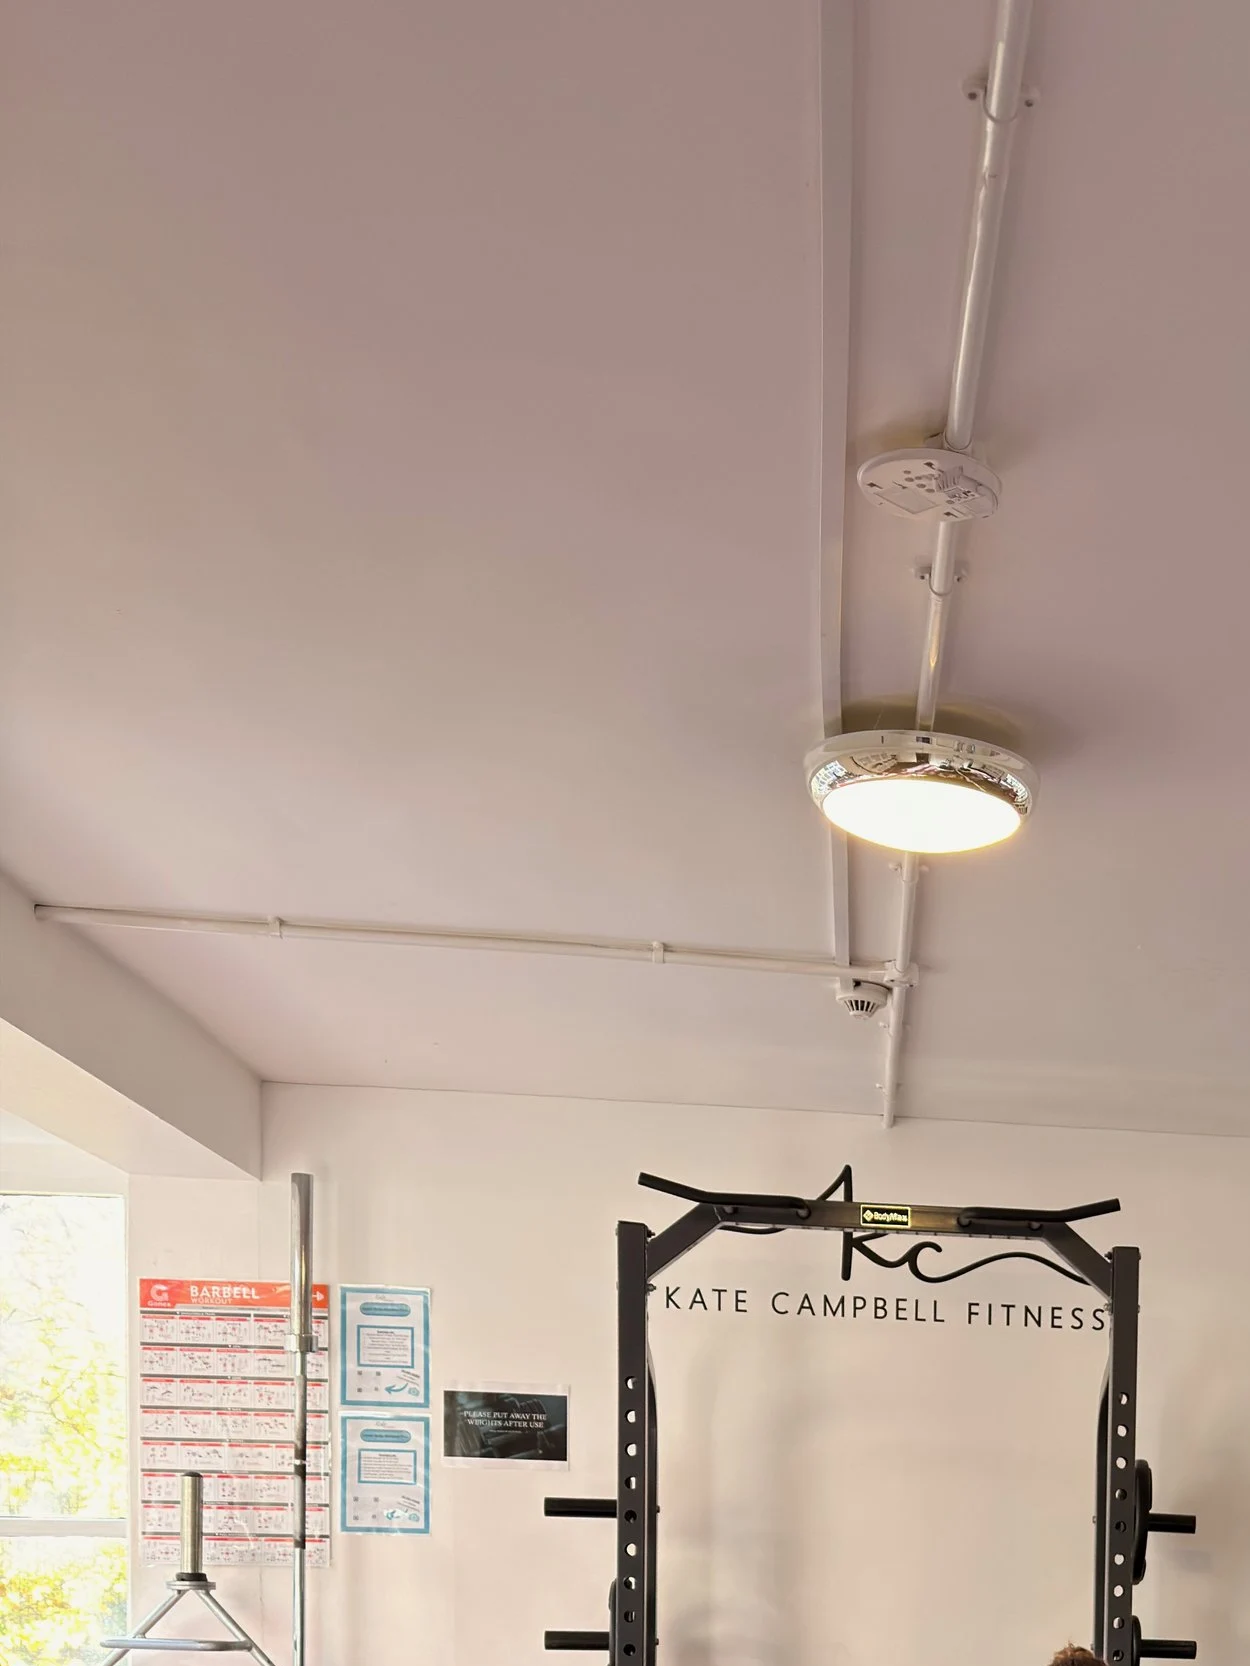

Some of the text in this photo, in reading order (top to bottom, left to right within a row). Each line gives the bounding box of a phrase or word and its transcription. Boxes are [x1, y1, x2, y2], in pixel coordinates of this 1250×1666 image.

[873, 1211, 908, 1223] BodyMax
[190, 1285, 260, 1299] BARBELL
[664, 1285, 1105, 1331] KATE CAMPBELL FITNESS
[463, 1410, 492, 1418] PLEASE
[509, 1412, 531, 1420] AWAY
[532, 1413, 547, 1421] THE
[467, 1418, 502, 1427] WEIGHTS
[503, 1420, 528, 1428] AFTER
